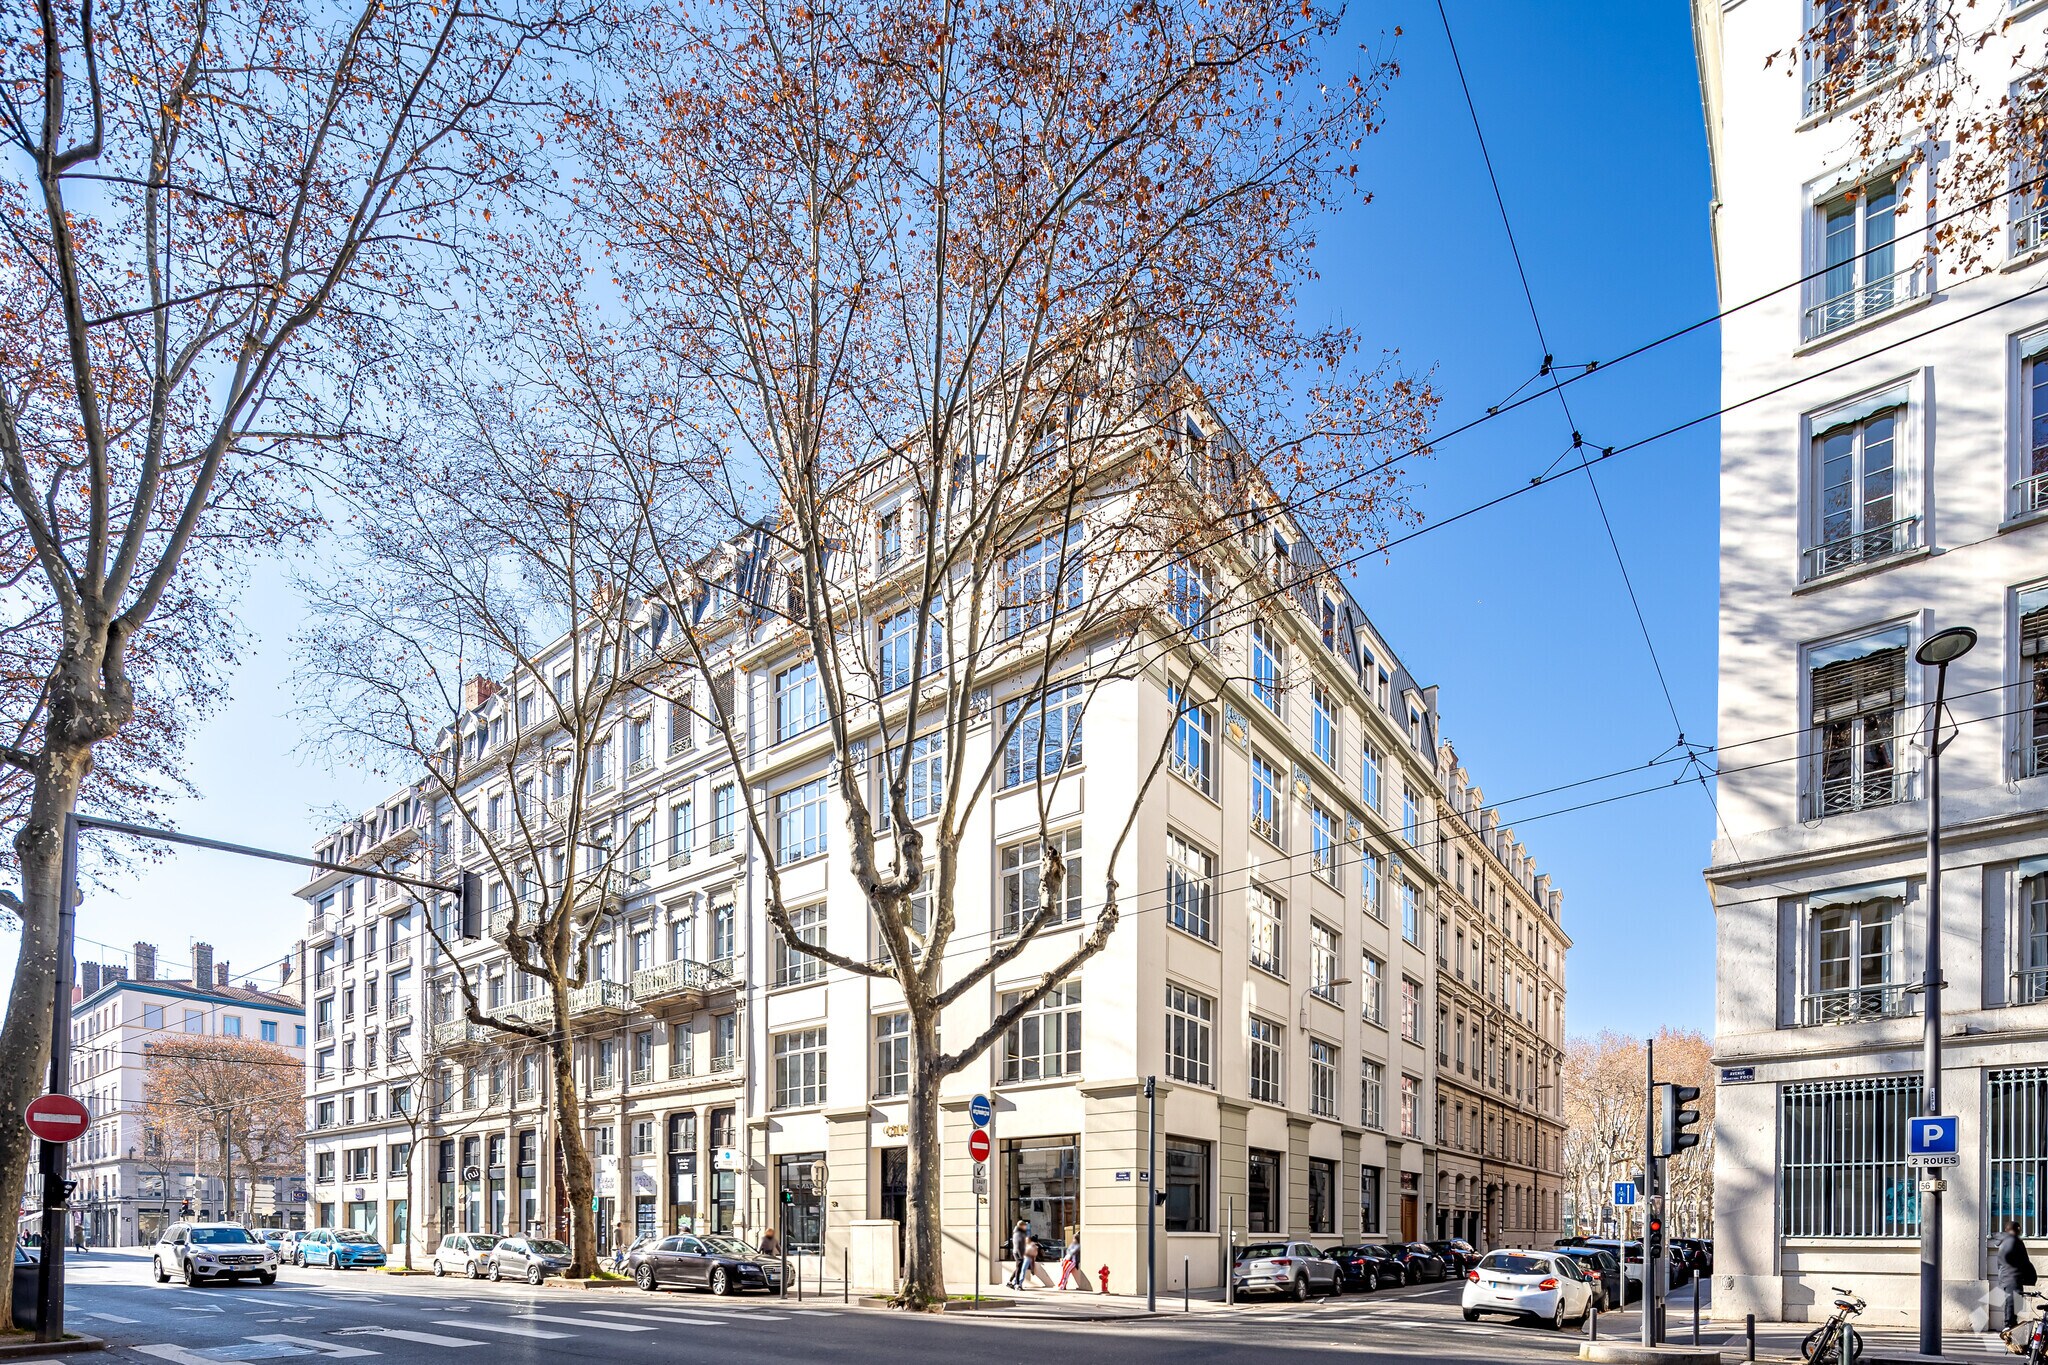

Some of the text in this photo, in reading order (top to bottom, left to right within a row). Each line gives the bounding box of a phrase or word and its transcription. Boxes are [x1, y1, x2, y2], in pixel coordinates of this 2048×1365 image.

[1923, 1124, 1944, 1147] P
[1923, 1157, 1957, 1165] ROUES
[1920, 1182, 1931, 1190] 56
[1937, 1181, 1946, 1190] 56
